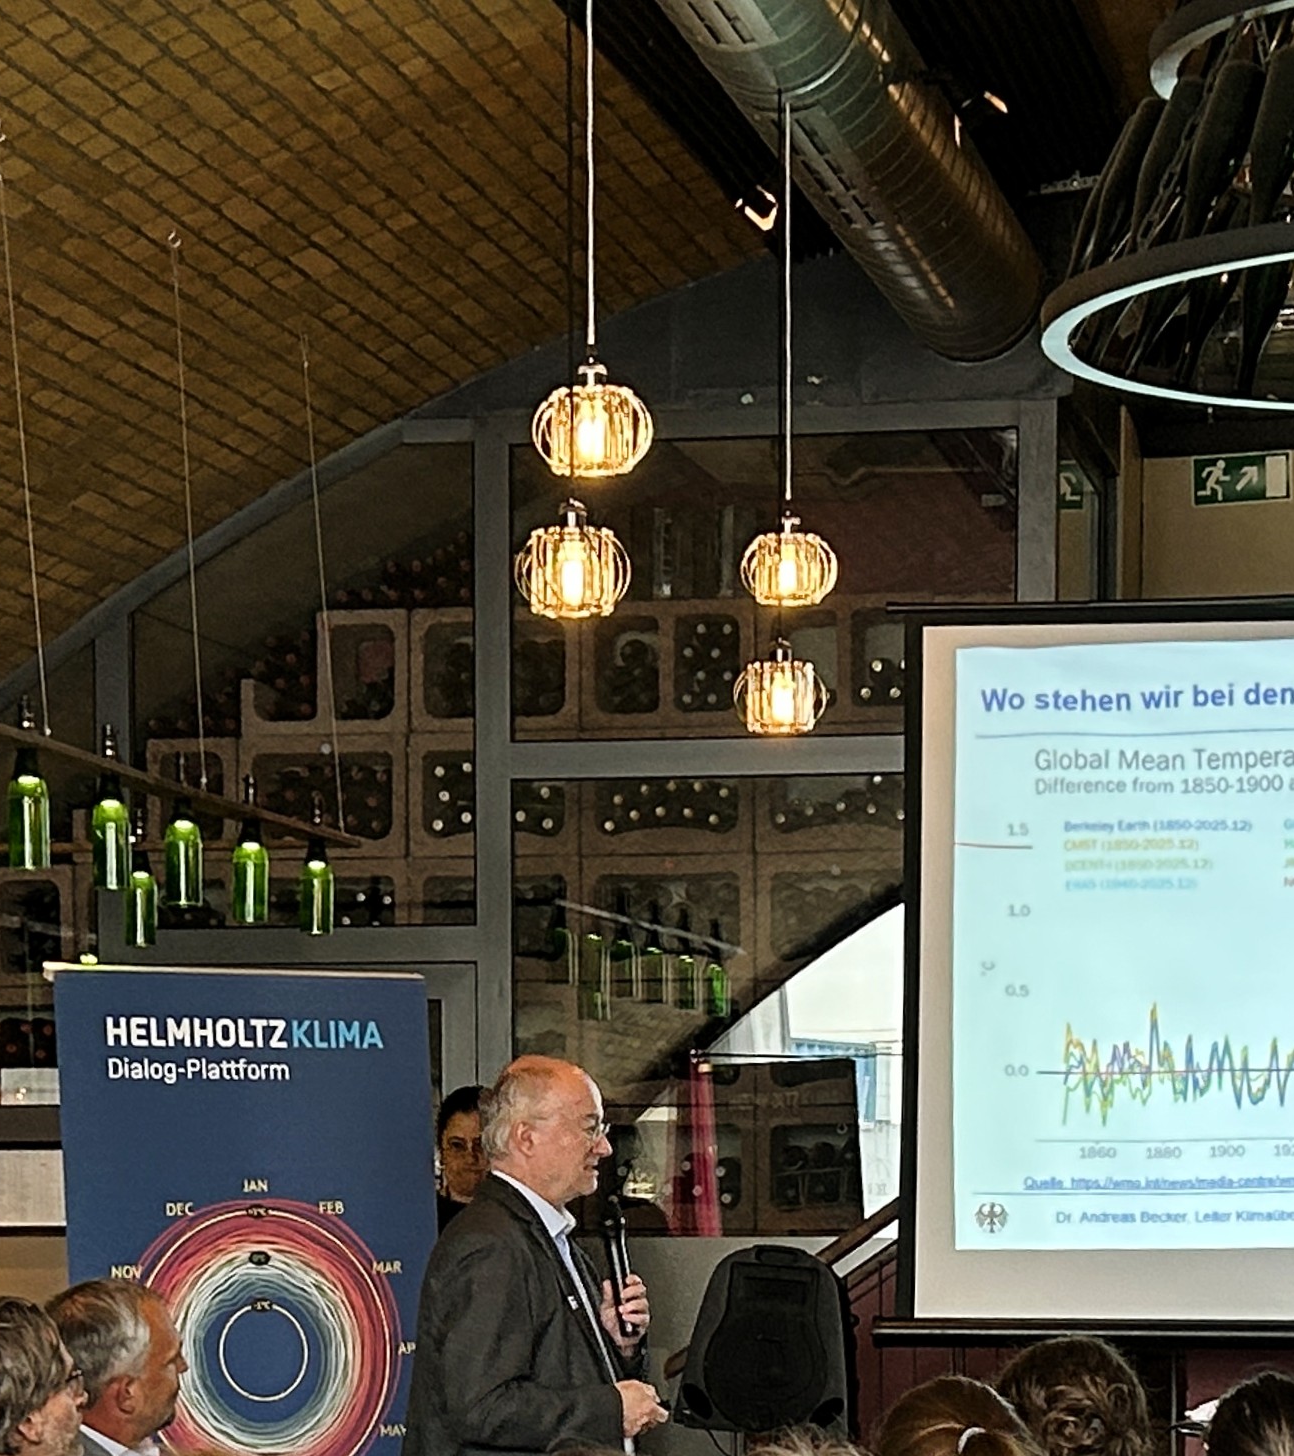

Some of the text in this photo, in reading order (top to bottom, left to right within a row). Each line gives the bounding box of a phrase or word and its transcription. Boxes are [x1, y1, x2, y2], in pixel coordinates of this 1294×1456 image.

[981, 688, 1025, 712] Wo
[1035, 688, 1132, 712] stehen
[1141, 685, 1184, 709] wir
[1193, 683, 1235, 707] bei
[1035, 748, 1110, 772] Global
[1118, 748, 1186, 772] Mean
[1035, 777, 1127, 795] Difference
[1132, 777, 1174, 794] from
[1180, 776, 1284, 794] 1850-1900
[1007, 823, 1029, 837] 1.5
[1117, 819, 1150, 832] Earth
[1008, 904, 1031, 917] 1.0
[1004, 984, 1030, 998] 0.5
[108, 1056, 290, 1084] Dialog-Plattform
[1004, 1064, 1030, 1077] 0.0
[1079, 1146, 1117, 1159] 1860
[1146, 1145, 1182, 1159] 1880
[1209, 1144, 1246, 1158] 1900
[243, 1179, 269, 1193] JAN
[166, 1202, 195, 1217] DEC
[318, 1200, 345, 1216] FEB
[1079, 1211, 1137, 1224] Andreas
[1195, 1210, 1232, 1223] Leiter
[111, 1265, 142, 1281] NOV
[372, 1260, 402, 1275] MAR
[397, 1341, 417, 1356] AP
